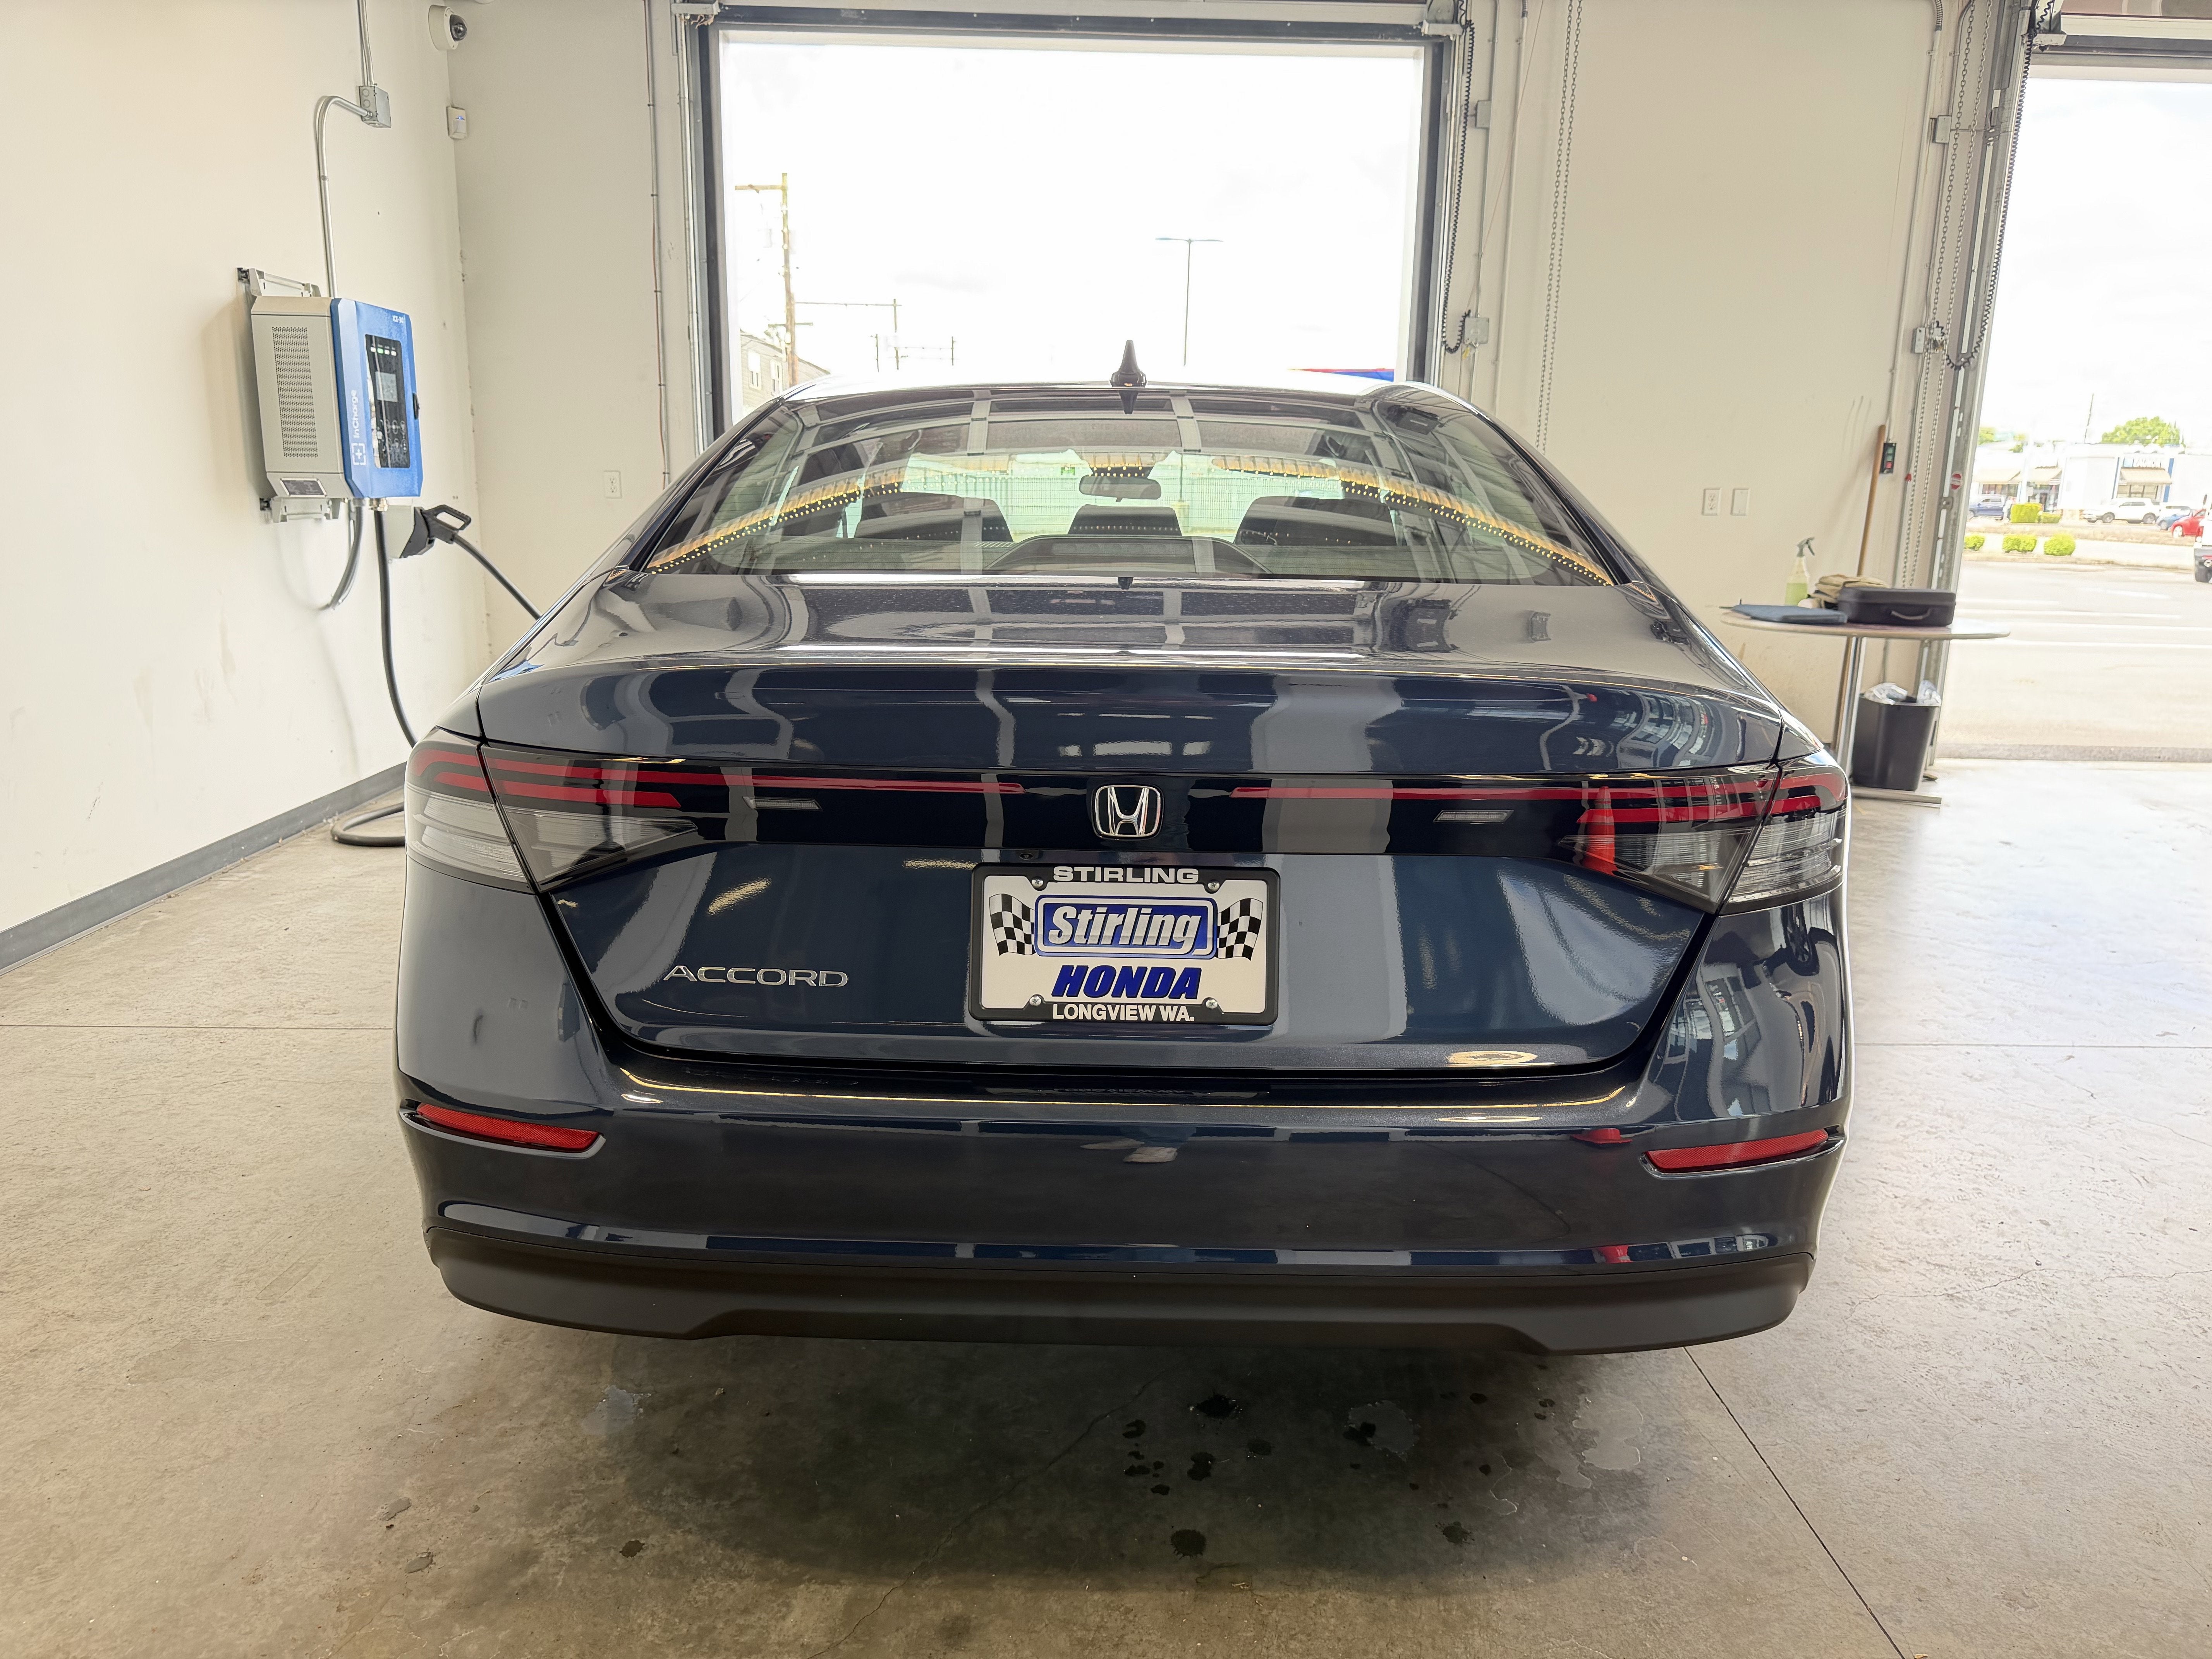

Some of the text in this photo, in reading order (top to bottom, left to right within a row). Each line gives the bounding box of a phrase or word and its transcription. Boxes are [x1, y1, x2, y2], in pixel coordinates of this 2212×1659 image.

[350, 389, 360, 438] InCharge
[1053, 866, 1199, 883] STIRLING
[1048, 905, 1202, 955] Stirling
[663, 965, 848, 987] ACCORD
[1051, 965, 1202, 1000] HONDA
[1053, 1003, 1195, 1022] LONGVIEW WA.
